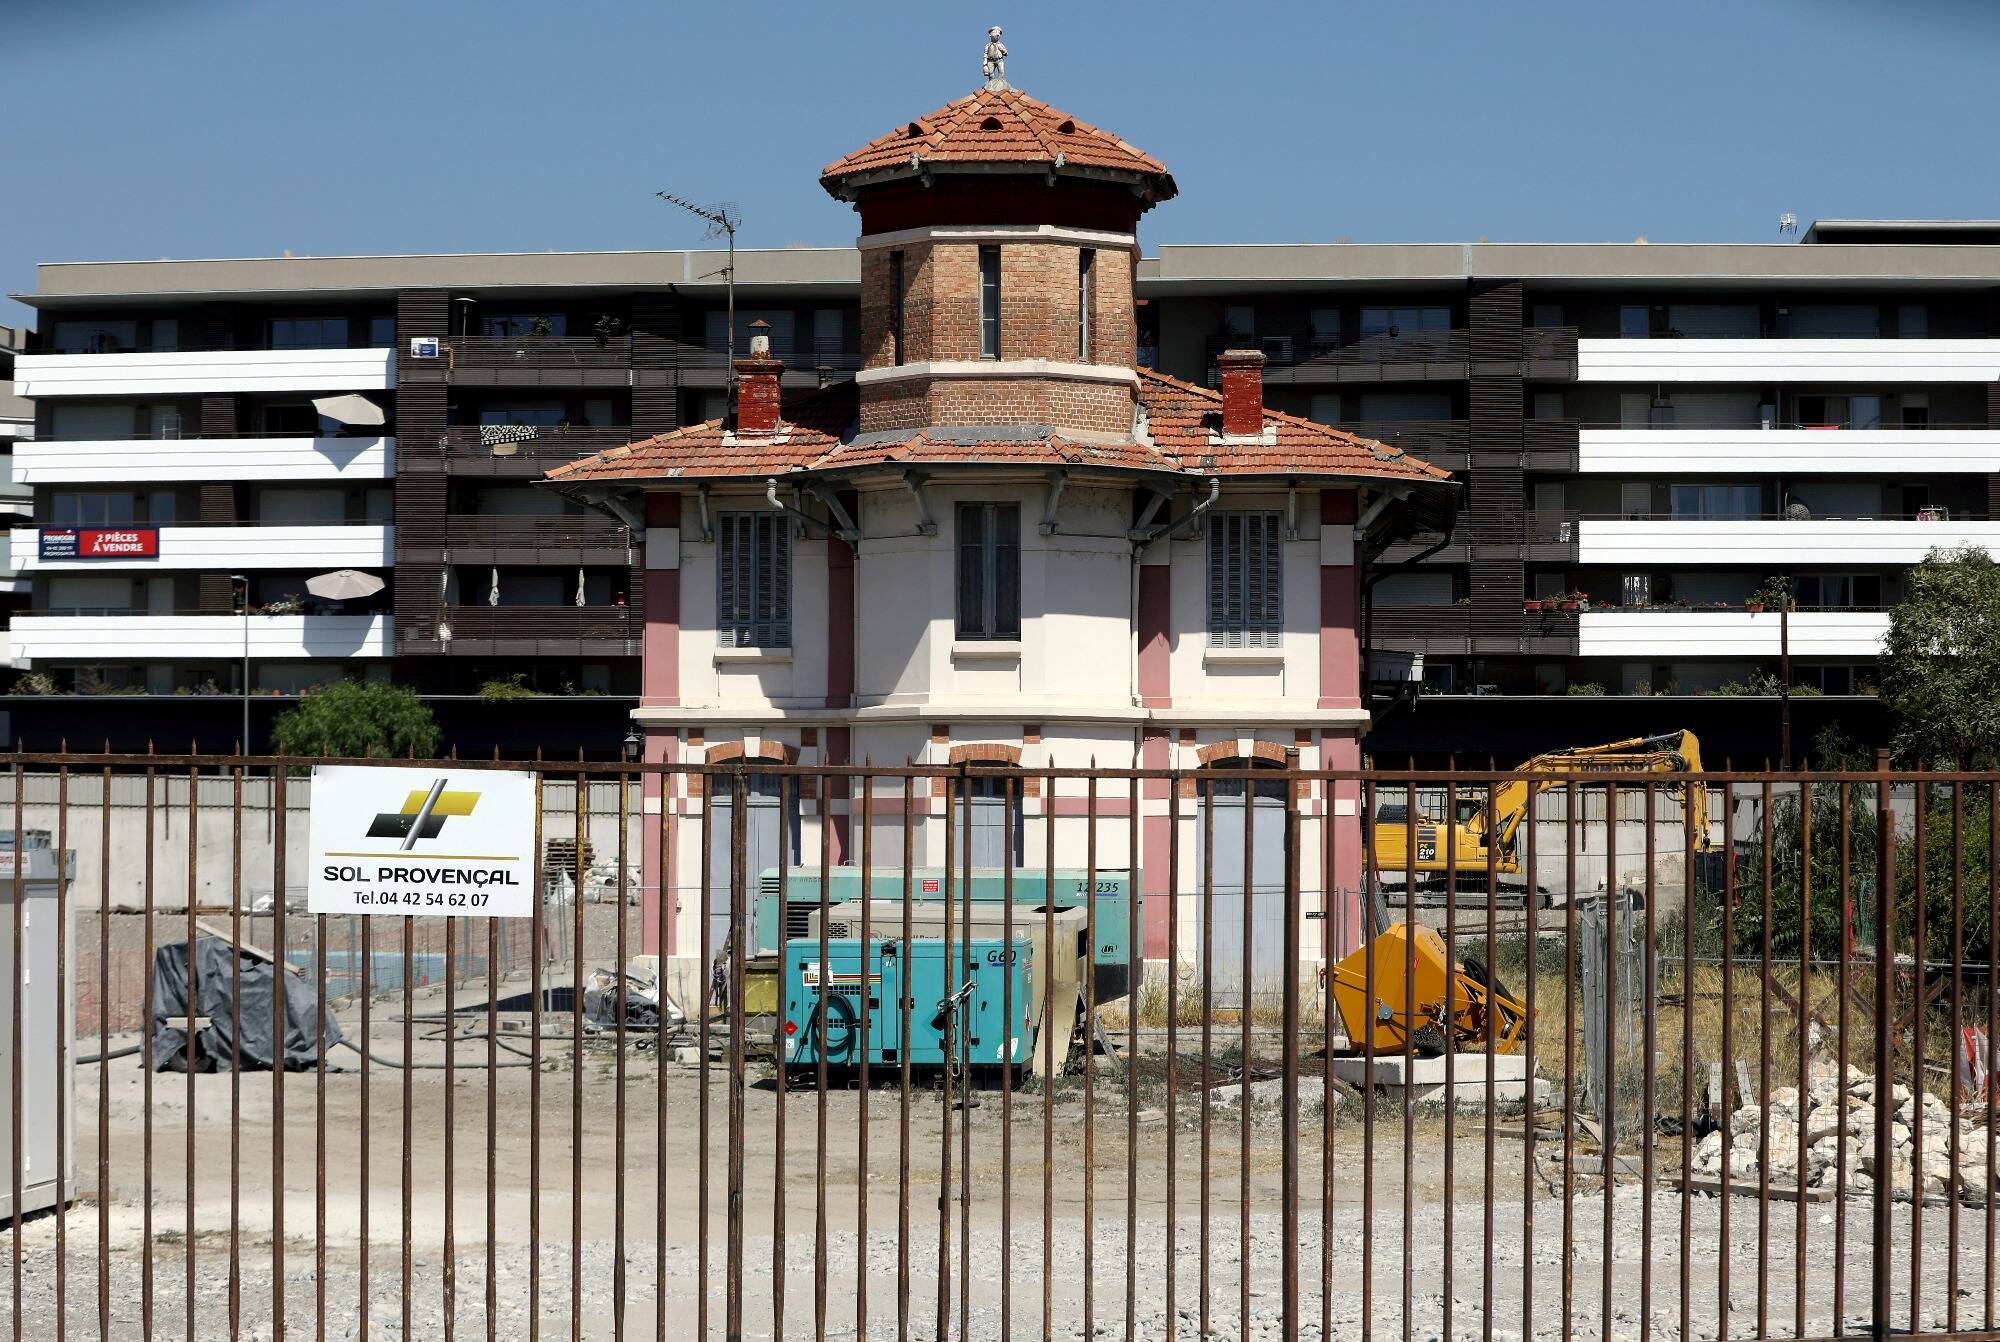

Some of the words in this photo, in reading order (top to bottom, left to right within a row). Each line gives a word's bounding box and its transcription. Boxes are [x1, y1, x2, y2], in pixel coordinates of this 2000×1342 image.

[97, 534, 104, 542] 2
[105, 531, 138, 542] PIÈCES
[93, 541, 101, 553] À
[103, 543, 143, 552] VENDRE
[1419, 848, 1435, 856] 210
[323, 866, 371, 882] SOL
[377, 867, 520, 888] PROVENÇAL
[1076, 882, 1119, 893] 12235
[353, 891, 399, 905] Tel.04
[402, 892, 421, 906] 42
[425, 893, 444, 906] 54
[448, 894, 467, 907] 62
[471, 894, 489, 907] 07
[987, 950, 1017, 963] G60
